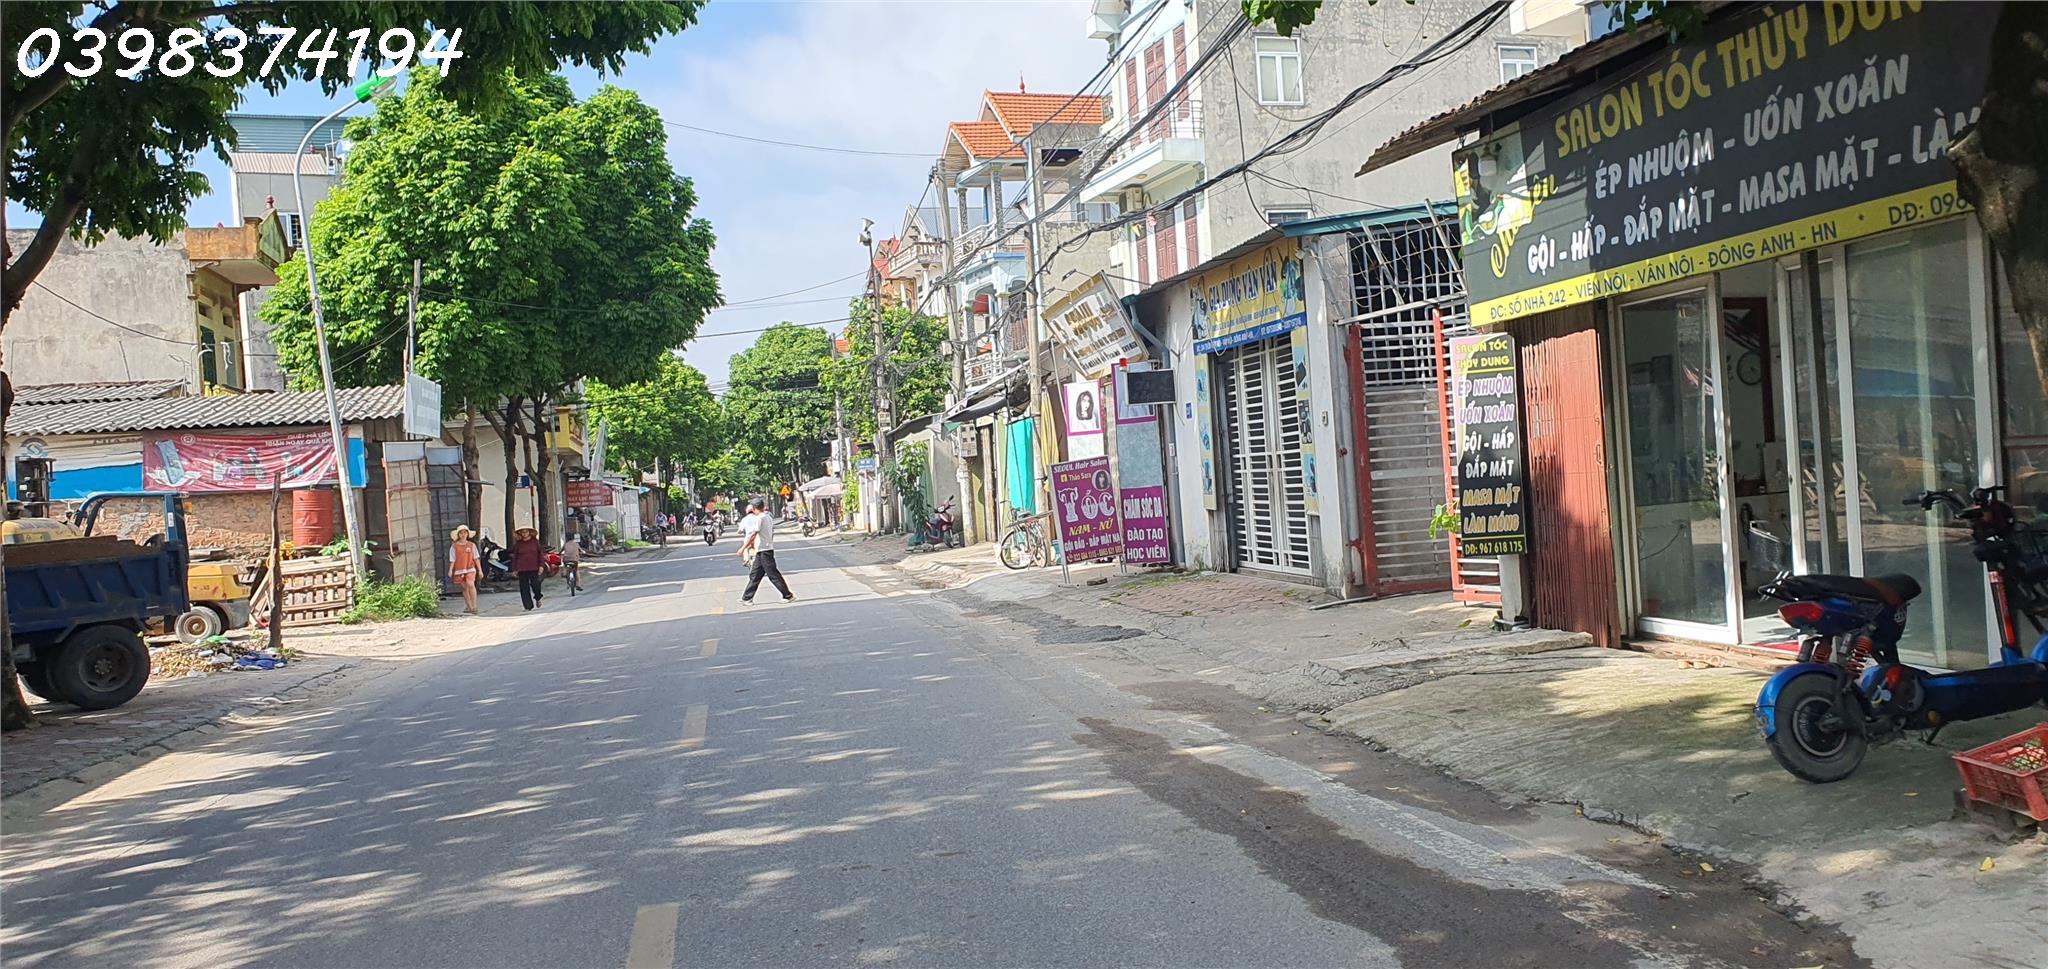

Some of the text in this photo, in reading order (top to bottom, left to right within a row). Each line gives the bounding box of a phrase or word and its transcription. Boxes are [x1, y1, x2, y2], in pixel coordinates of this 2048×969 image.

[1555, 82, 1643, 158] SALON
[1648, 49, 1712, 117] TÓC
[1716, 4, 1809, 88] THÙY
[1595, 159, 1622, 199] ÉP
[1628, 128, 1715, 189] NHUỘM
[1744, 85, 1803, 147] UỐN
[1814, 54, 1909, 123] XOĂN
[1528, 234, 1556, 276] GỘI
[1571, 214, 1606, 262] HẤP
[1624, 195, 1662, 246] ĐẮP
[1669, 186, 1715, 234] MẶT
[1739, 162, 1807, 214] MASA
[1816, 136, 1879, 191] MẶT
[1490, 306, 1508, 320] ĐC:
[1509, 294, 1522, 315] SỐ
[1524, 289, 1546, 311] NHÀ
[1548, 289, 1567, 306] 242
[1576, 280, 1601, 300] VIÊN
[1604, 272, 1627, 295] NỘI
[1637, 261, 1666, 285] VÂN
[1669, 254, 1695, 277] NỘI
[1708, 243, 1756, 268] ĐÔNG
[1760, 231, 1795, 256] ANH
[1811, 221, 1837, 243] HN
[1455, 338, 1508, 354] SALON TÓC
[1480, 355, 1510, 367] DUNG
[1473, 373, 1514, 398] NHUỘM
[1459, 400, 1482, 424] UỐN
[1464, 431, 1482, 454] GỘI
[1492, 425, 1514, 449] HẤP
[1054, 458, 1108, 474] SEOUL Hair Salon
[1465, 454, 1514, 479] ĐẮP MẶT
[1141, 493, 1154, 519] SÓC
[1154, 496, 1163, 518] DA
[1462, 482, 1521, 507] MASA MẶT
[1068, 524, 1091, 536] NAM
[1098, 518, 1114, 531] NỮ
[1463, 510, 1520, 534] LÀM MÓNG
[1127, 527, 1164, 543] ĐÀO TẠO
[1126, 546, 1145, 561] HỌC
[1145, 544, 1167, 559] VIÊN
[1479, 542, 1492, 555] 967
[1494, 541, 1508, 554] 618
[1510, 540, 1523, 553] 175
